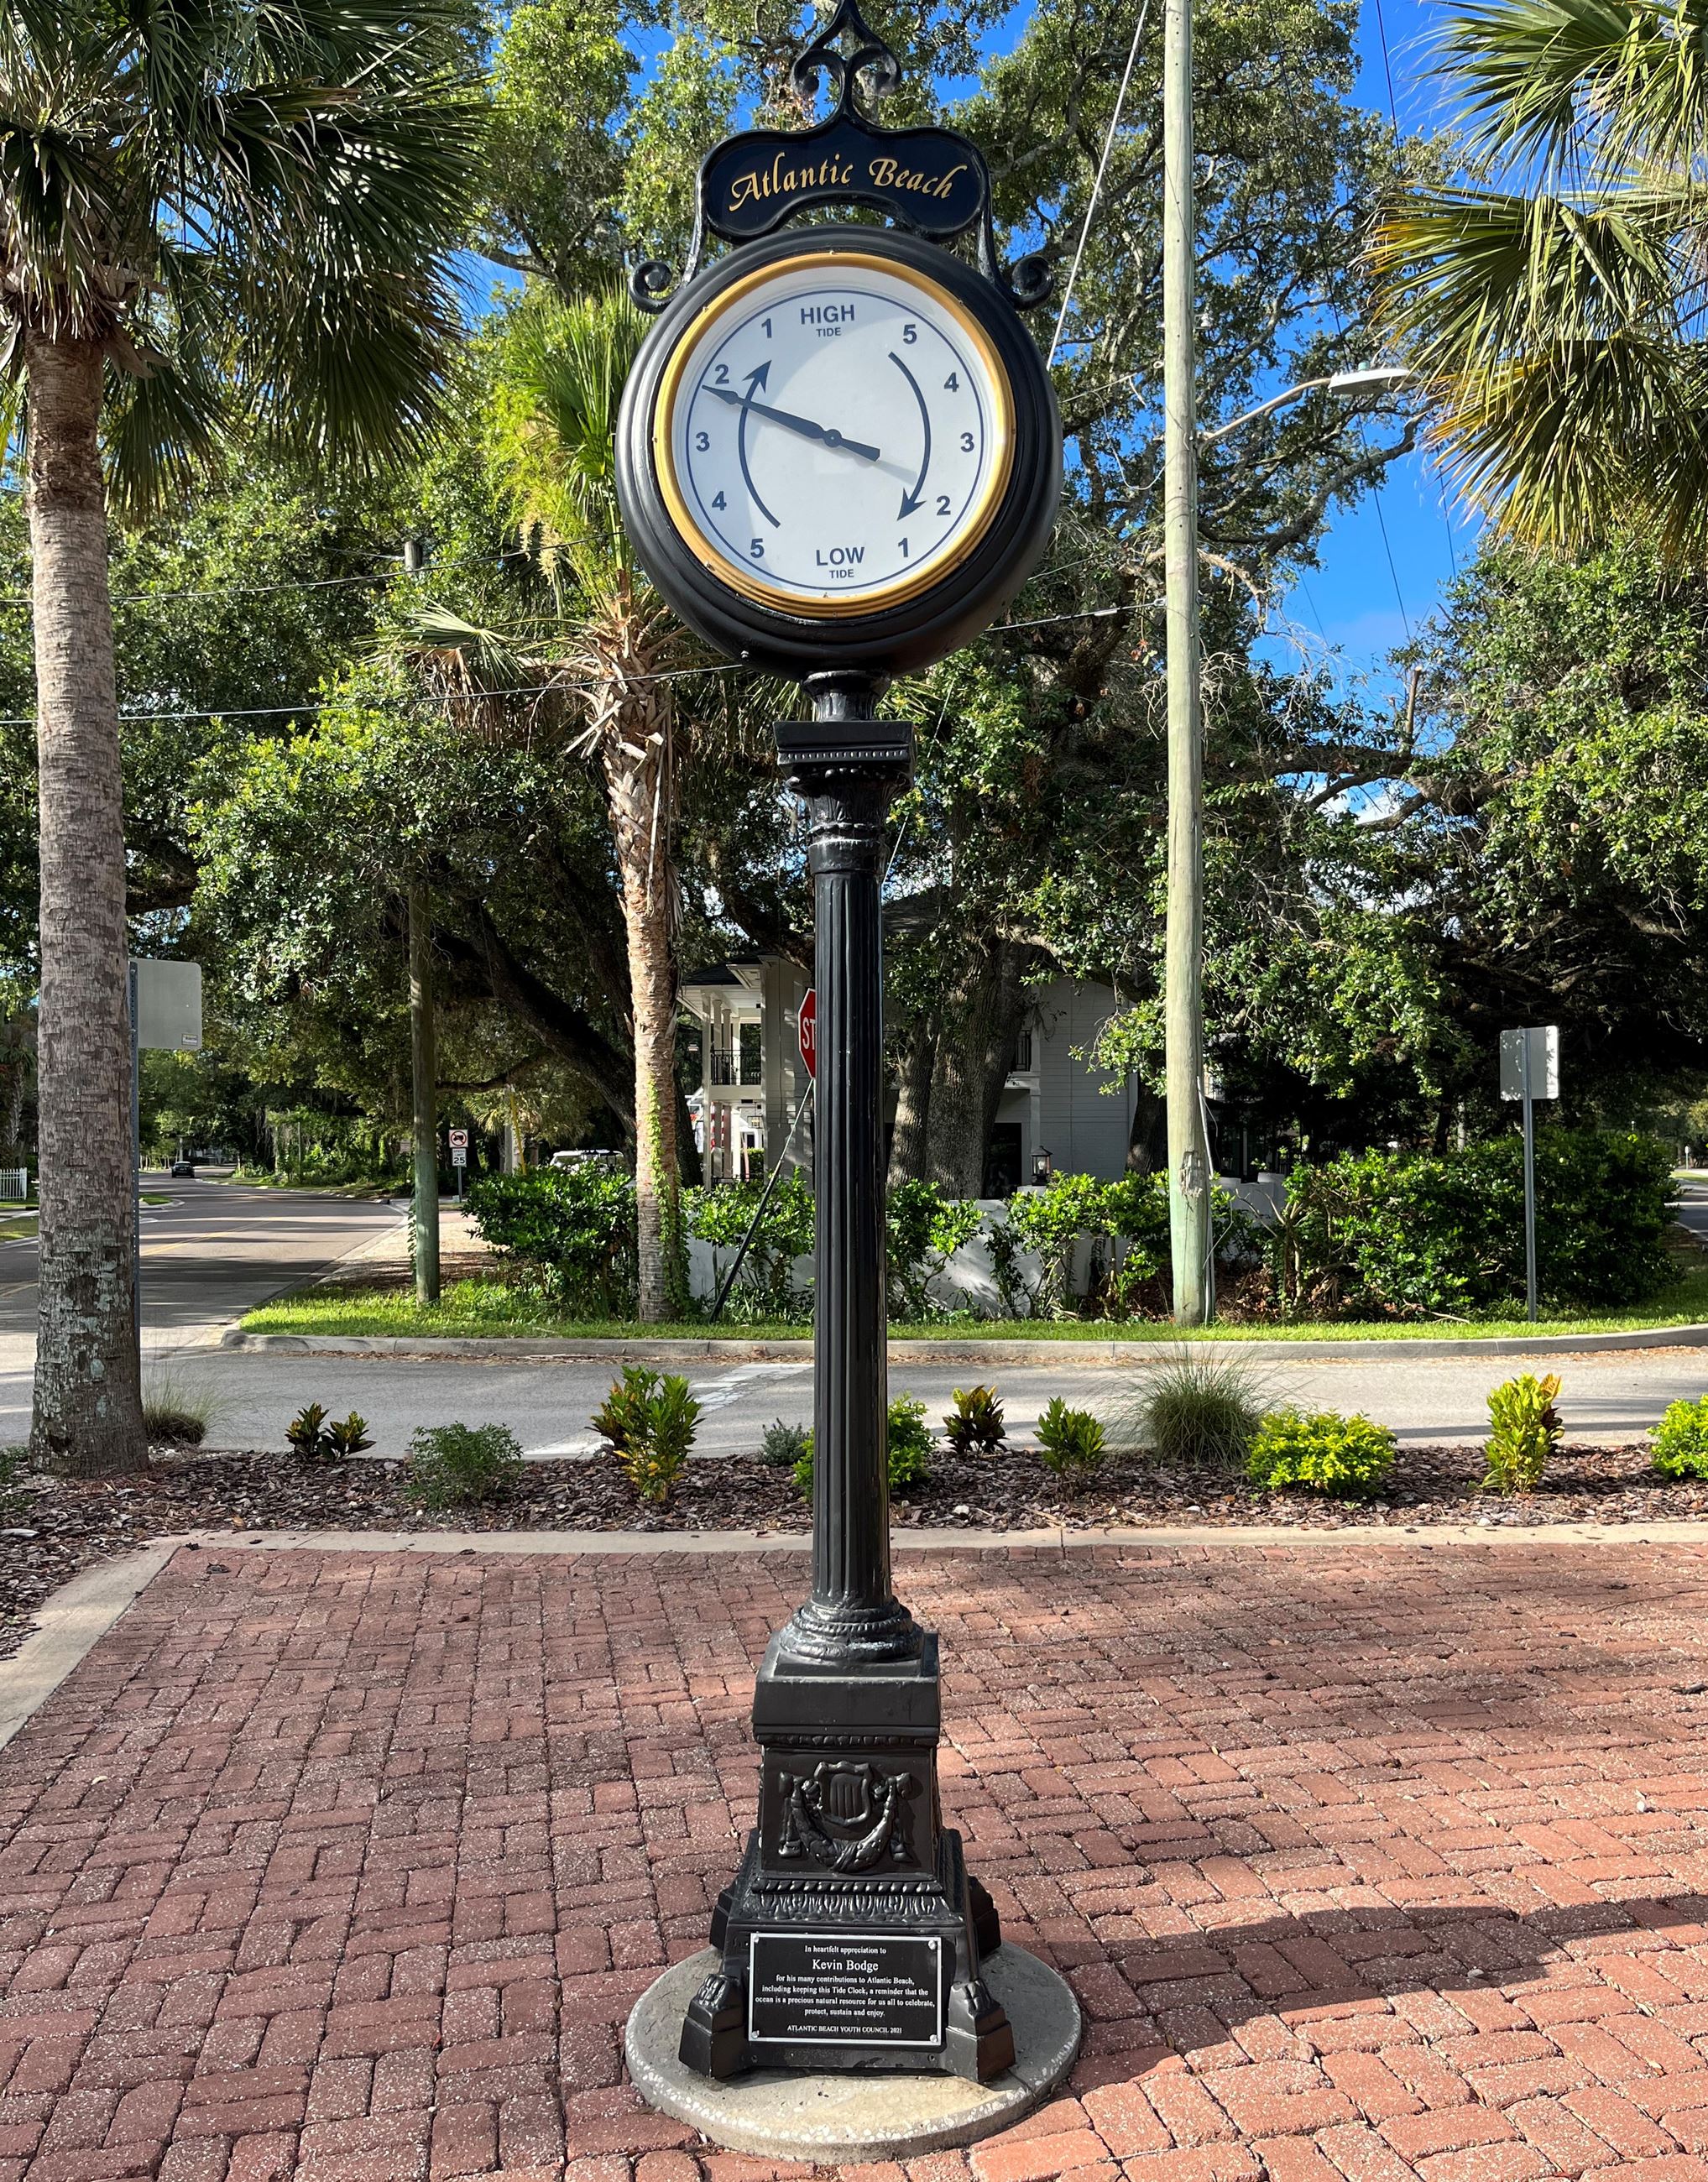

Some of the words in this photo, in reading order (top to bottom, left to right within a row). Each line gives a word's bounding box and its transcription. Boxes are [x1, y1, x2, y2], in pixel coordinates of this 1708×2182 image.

[729, 151, 854, 211] Atlantic
[869, 158, 968, 200] Beach
[800, 304, 855, 325] HIGH
[761, 318, 772, 338] 1
[816, 327, 841, 337] TIDE
[903, 324, 917, 344] 5
[714, 363, 729, 384] 2
[943, 372, 959, 393] 4
[696, 431, 710, 452] 3
[960, 432, 974, 452] 3
[712, 490, 727, 510] 4
[937, 495, 951, 516] 2
[750, 538, 764, 559] 5
[816, 546, 864, 566] LOW
[897, 537, 909, 558] 1
[829, 569, 854, 579] TIDE
[802, 1016, 816, 1050] ST
[840, 1946, 878, 1955] appreciation
[812, 1959, 843, 1970] Kevin
[846, 1960, 879, 1973] Bodge
[762, 1985, 791, 1993] including
[792, 1986, 817, 1994] keeping
[893, 1977, 914, 1986] Beach,
[788, 1997, 814, 2006] precious
[905, 1999, 935, 2007] celebrate,
[867, 2008, 885, 2018] enjoy.
